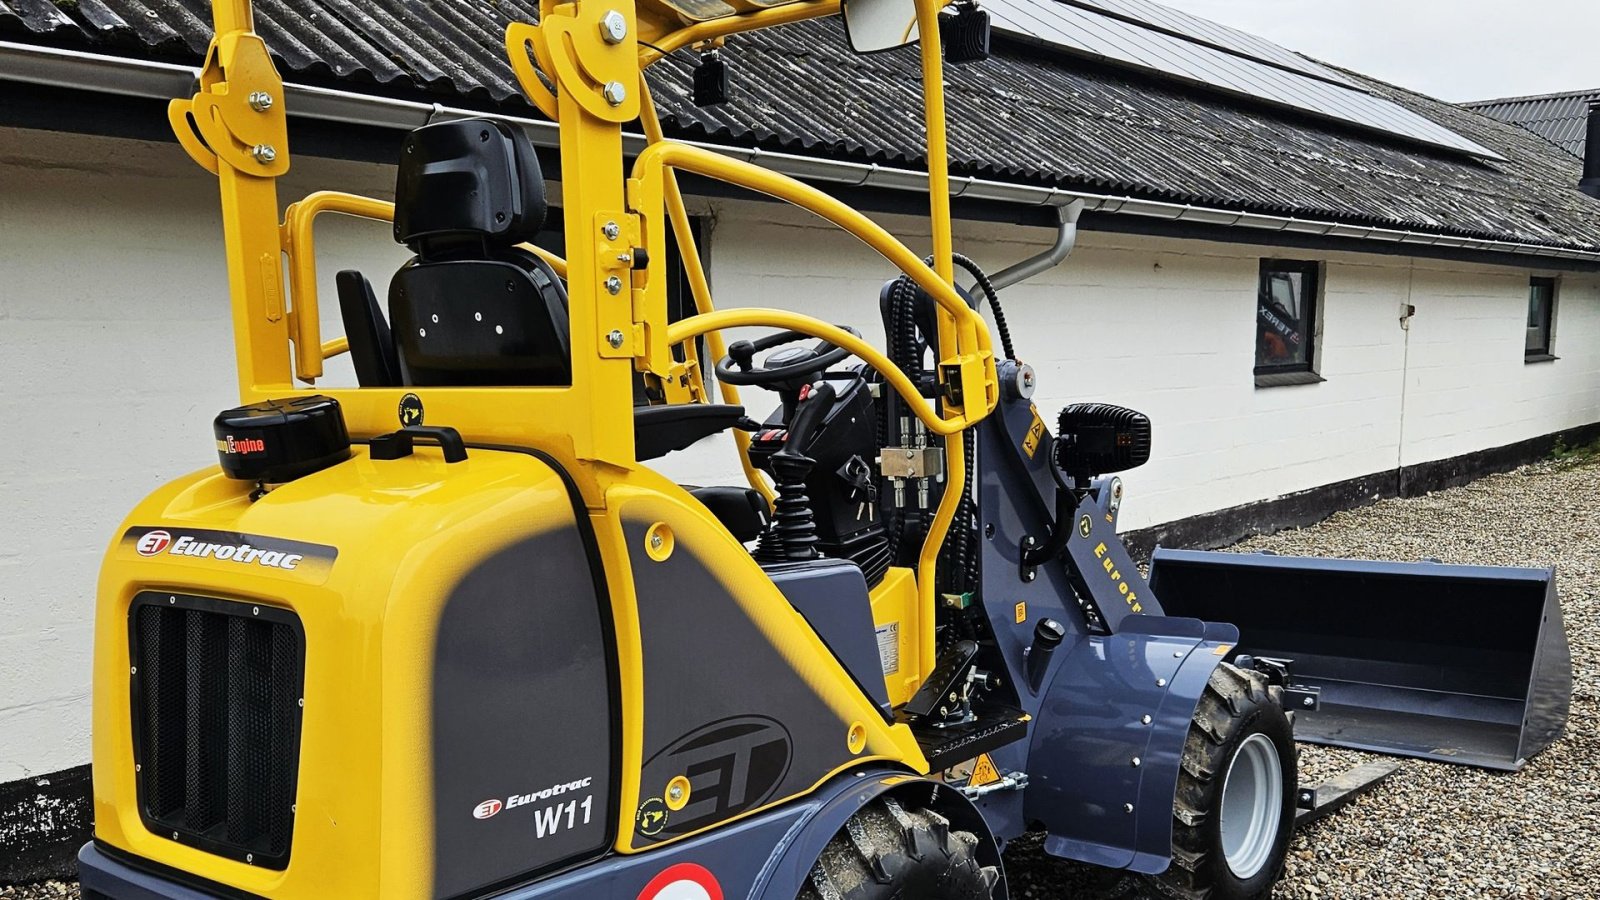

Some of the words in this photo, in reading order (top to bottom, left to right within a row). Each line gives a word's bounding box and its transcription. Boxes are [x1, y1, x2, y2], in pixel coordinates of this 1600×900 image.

[138, 532, 170, 555] ET
[169, 536, 303, 570] Eurotrac
[1094, 542, 1142, 612] Eurotr
[475, 801, 501, 818] ET
[505, 777, 592, 810] Eurotrac
[660, 723, 789, 828] ET
[534, 795, 592, 839] W11
